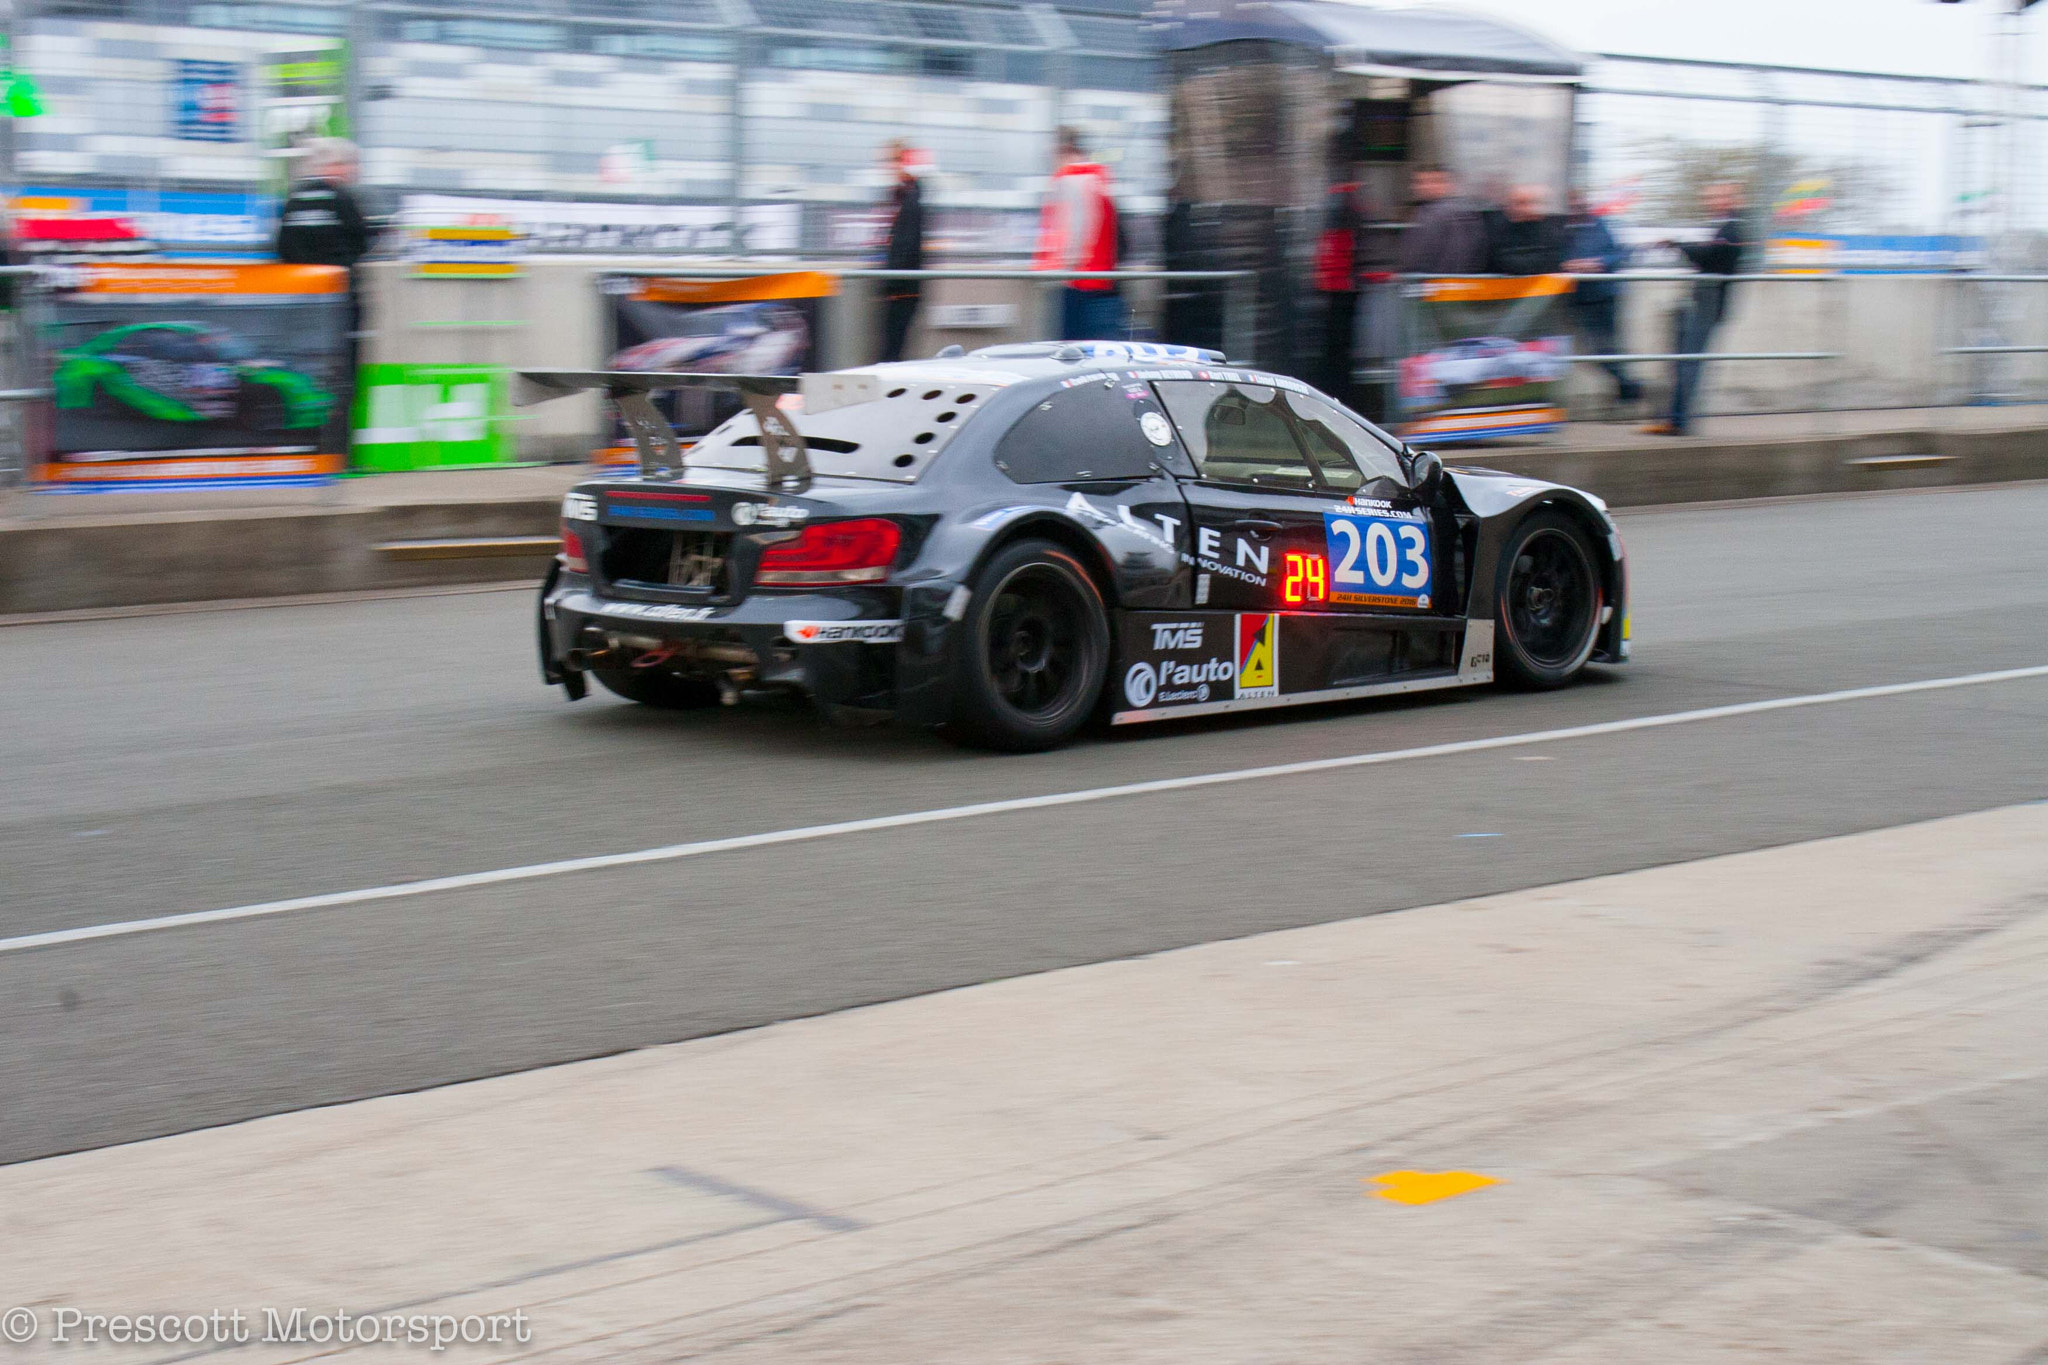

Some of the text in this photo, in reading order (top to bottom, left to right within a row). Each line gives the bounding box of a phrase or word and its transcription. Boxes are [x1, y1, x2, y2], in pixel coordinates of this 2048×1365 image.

[1066, 492, 1268, 574] ALTEN
[1330, 519, 1429, 588] 203
[1181, 551, 1268, 588] INNOVATION
[1284, 553, 1325, 602] 24
[1150, 622, 1204, 650] TMS
[1158, 656, 1235, 686] l'auto
